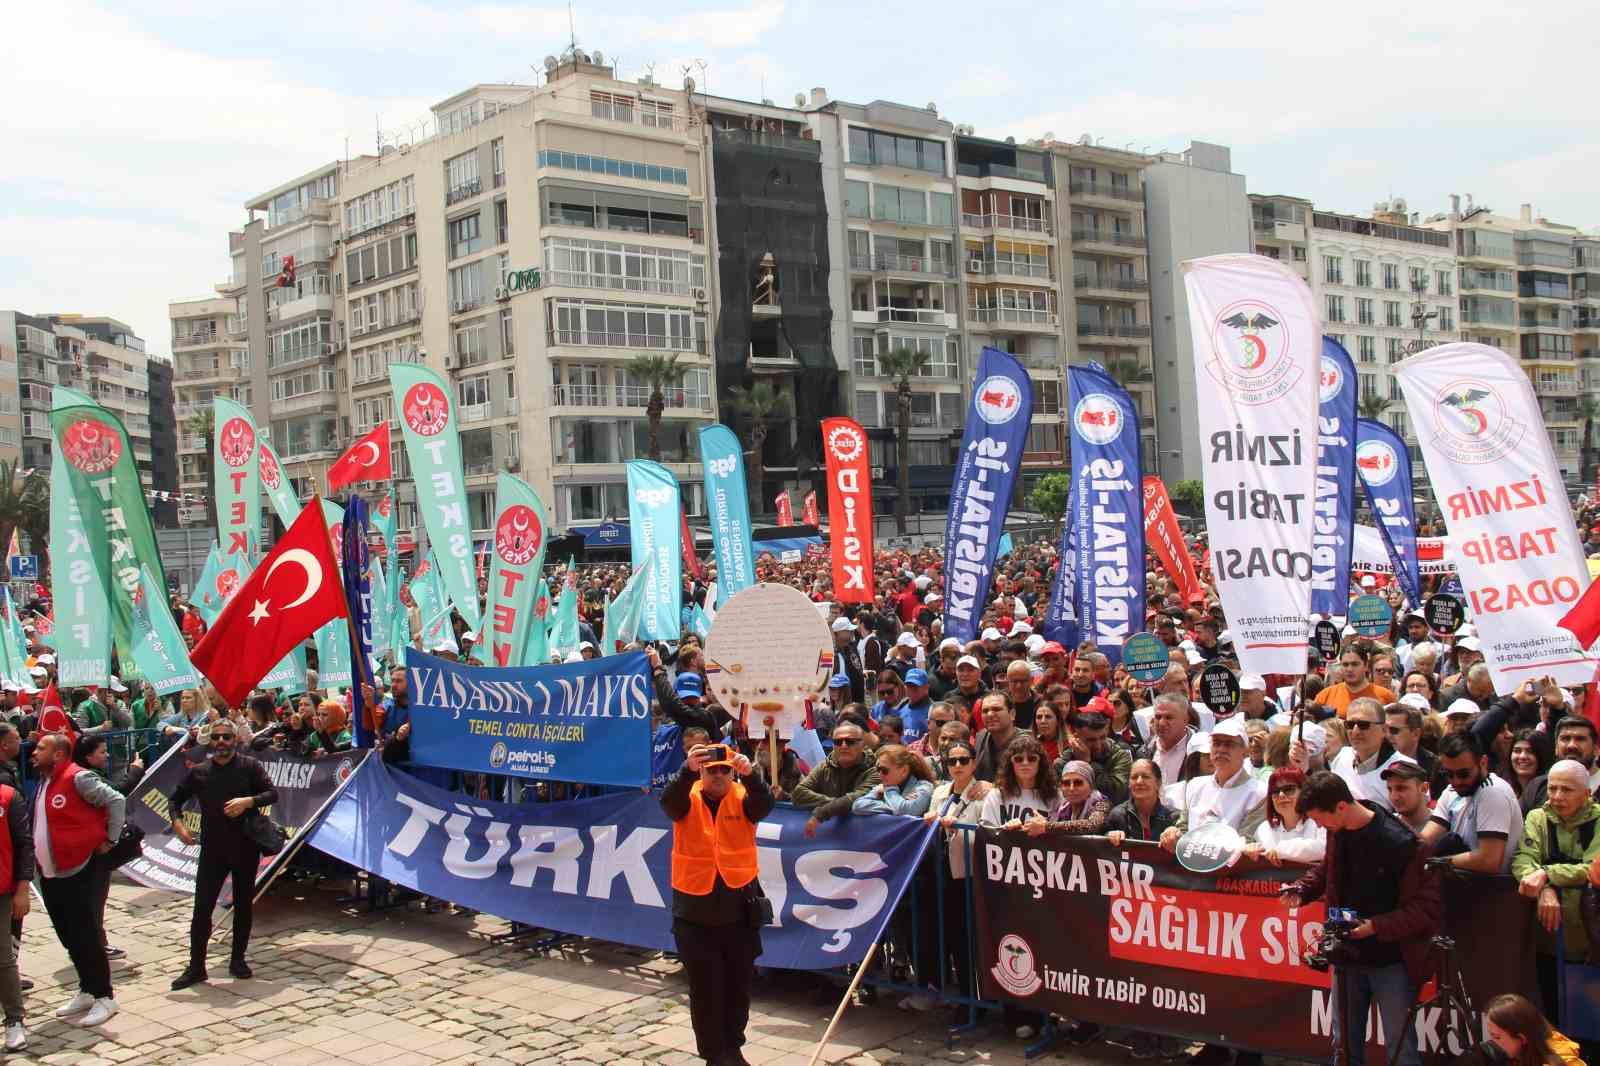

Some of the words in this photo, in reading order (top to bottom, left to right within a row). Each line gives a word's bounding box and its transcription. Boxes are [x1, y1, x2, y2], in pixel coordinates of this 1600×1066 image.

[19, 557, 29, 571] P
[1351, 560, 1372, 572] MİR
[411, 667, 534, 719] YAŞASIN
[535, 681, 552, 716] 1
[554, 672, 650, 720] MAYIS
[469, 719, 503, 737] TEMEL
[506, 721, 541, 738] CONTA
[542, 722, 585, 743] İŞÇİLERİ
[386, 792, 670, 908] TÜRK
[985, 843, 1088, 899] BAŞKA
[1097, 851, 1154, 901] BİR
[1109, 894, 1248, 961] SAĞLIK
[1260, 907, 1322, 967] SİS
[1043, 964, 1090, 997] İZMİR
[1095, 976, 1147, 1005] TABİP
[1152, 986, 1206, 1016] ODASI
